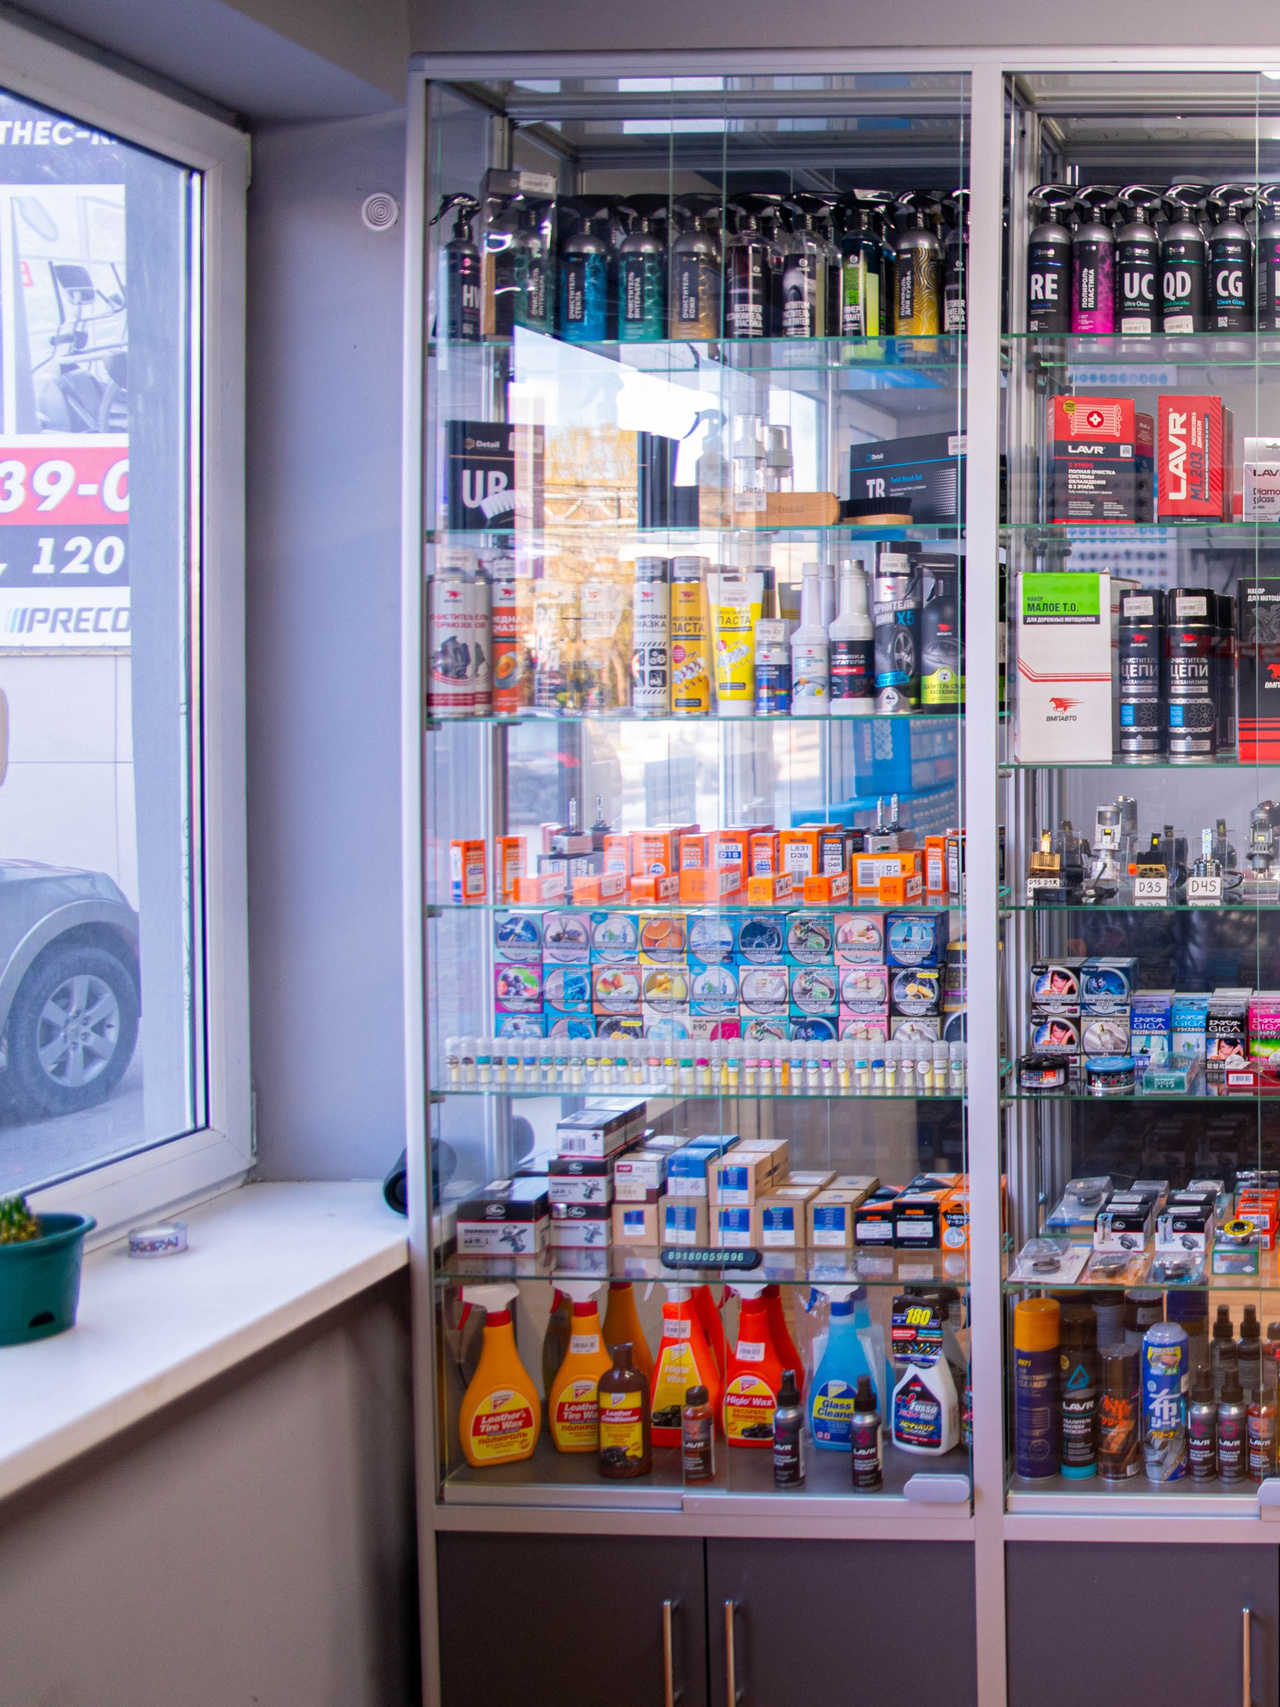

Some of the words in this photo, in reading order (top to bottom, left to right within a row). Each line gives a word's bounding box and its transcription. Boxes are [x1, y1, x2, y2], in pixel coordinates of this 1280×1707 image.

[1030, 273, 1059, 301] RE
[1123, 272, 1155, 301] UC
[1163, 270, 1192, 301] QD
[1216, 269, 1243, 298] CG
[568, 271, 576, 319] ОЧИСТИТЕЛЬ
[627, 270, 635, 319] ОЧИСТИТЕЛЬ
[634, 276, 642, 319] ИНТЕРЬЕРА
[1136, 300, 1150, 308] Clean
[1232, 299, 1246, 307] Glass
[476, 440, 500, 449] Detail
[1068, 444, 1104, 455] LAVR
[1168, 411, 1187, 500] LAVR
[32, 537, 126, 576] 120
[874, 599, 916, 615] ЕРНИТЕЛЬ
[1026, 602, 1061, 613] МАЛОЕ
[1062, 602, 1080, 613] Т.О.
[718, 616, 752, 626] ПАСТА
[1121, 664, 1159, 680] ЦЕПИ
[1170, 664, 1209, 680] ЦЕПИ
[1045, 714, 1078, 722] ВМПАВТО
[1138, 881, 1162, 893] D3S
[1191, 880, 1217, 893] D4S
[692, 1023, 708, 1032] R90
[1133, 1022, 1166, 1030] GIGA
[1208, 1025, 1241, 1033] GIGA
[668, 1250, 744, 1262] 89180059696
[905, 1307, 932, 1326] 180
[667, 1374, 687, 1384] Wax
[564, 1402, 598, 1412] Leathe
[752, 1398, 773, 1407] Wax
[821, 1400, 852, 1410] Glass
[1063, 1400, 1094, 1411] LAVR
[1148, 1388, 1182, 1420] 布
[481, 1410, 527, 1425] Leather's
[563, 1411, 582, 1420] Tire
[583, 1410, 598, 1420] Wa
[817, 1408, 854, 1419] Cleane
[479, 1423, 500, 1433] Tire
[500, 1419, 524, 1430] Wax
[1150, 1416, 1182, 1428] シート
[478, 1431, 529, 1446] ПОЛИРОЛЬ
